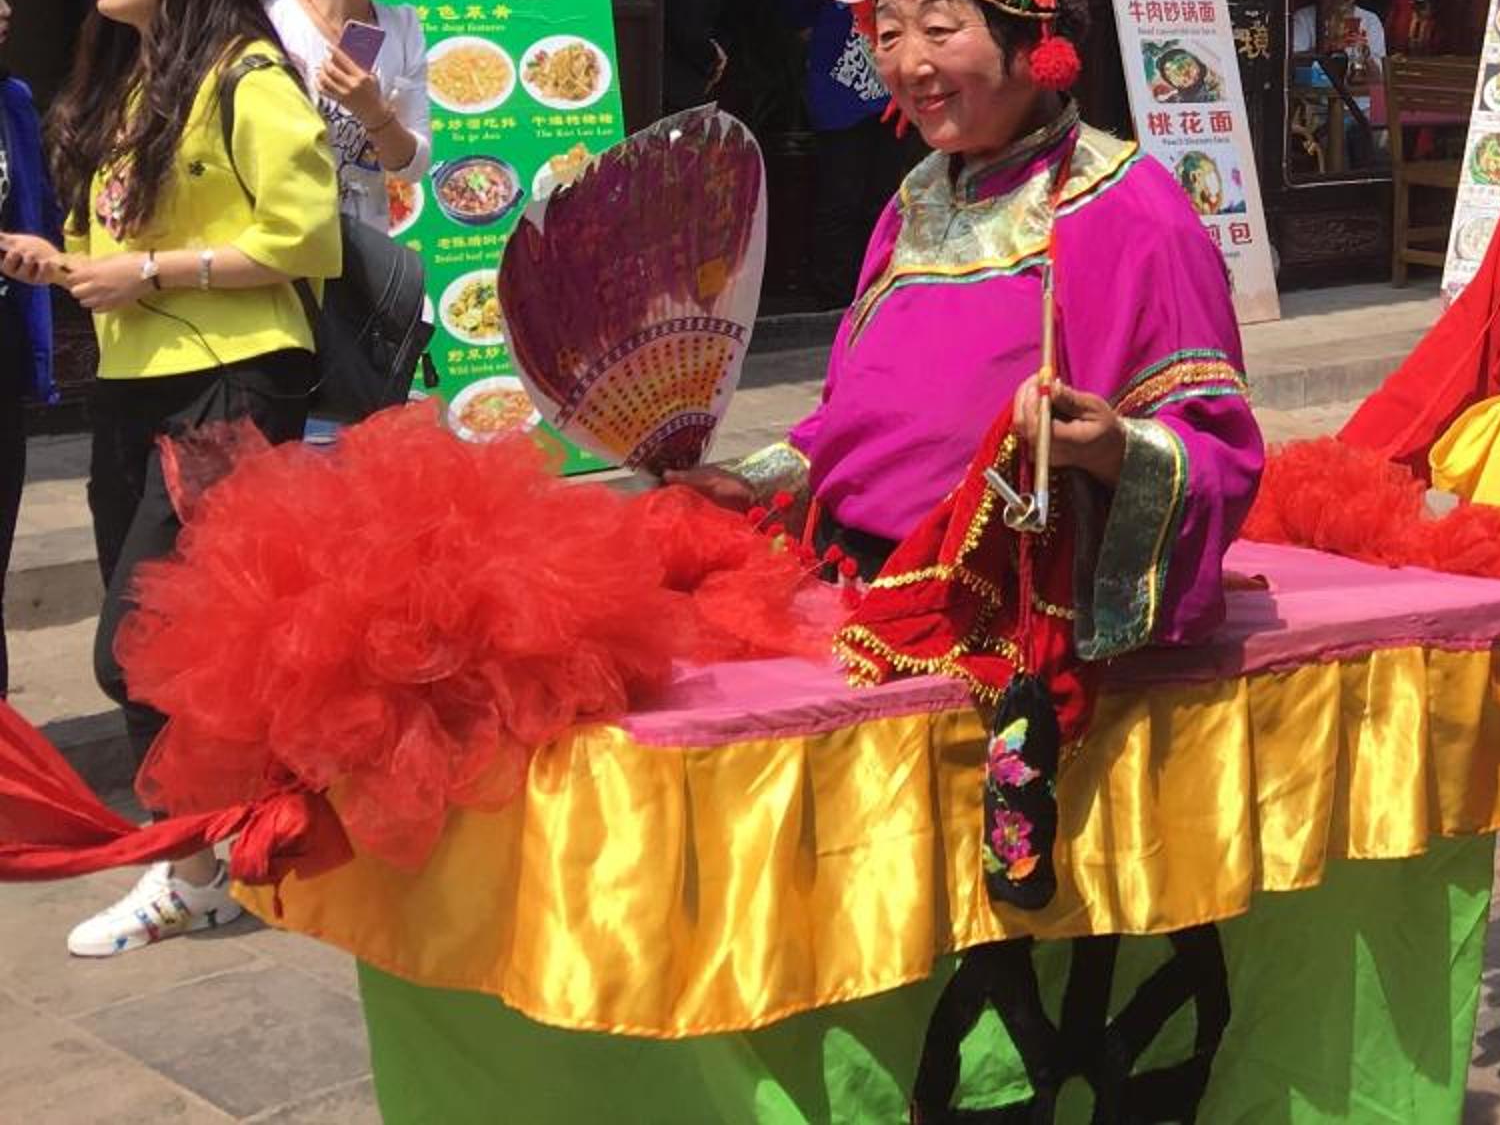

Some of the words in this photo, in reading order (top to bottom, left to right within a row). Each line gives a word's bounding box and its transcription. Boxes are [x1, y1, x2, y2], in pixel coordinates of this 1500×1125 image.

[1128, 0, 1217, 23] 牛肉砂锅面
[1147, 110, 1233, 136] 桃花面
